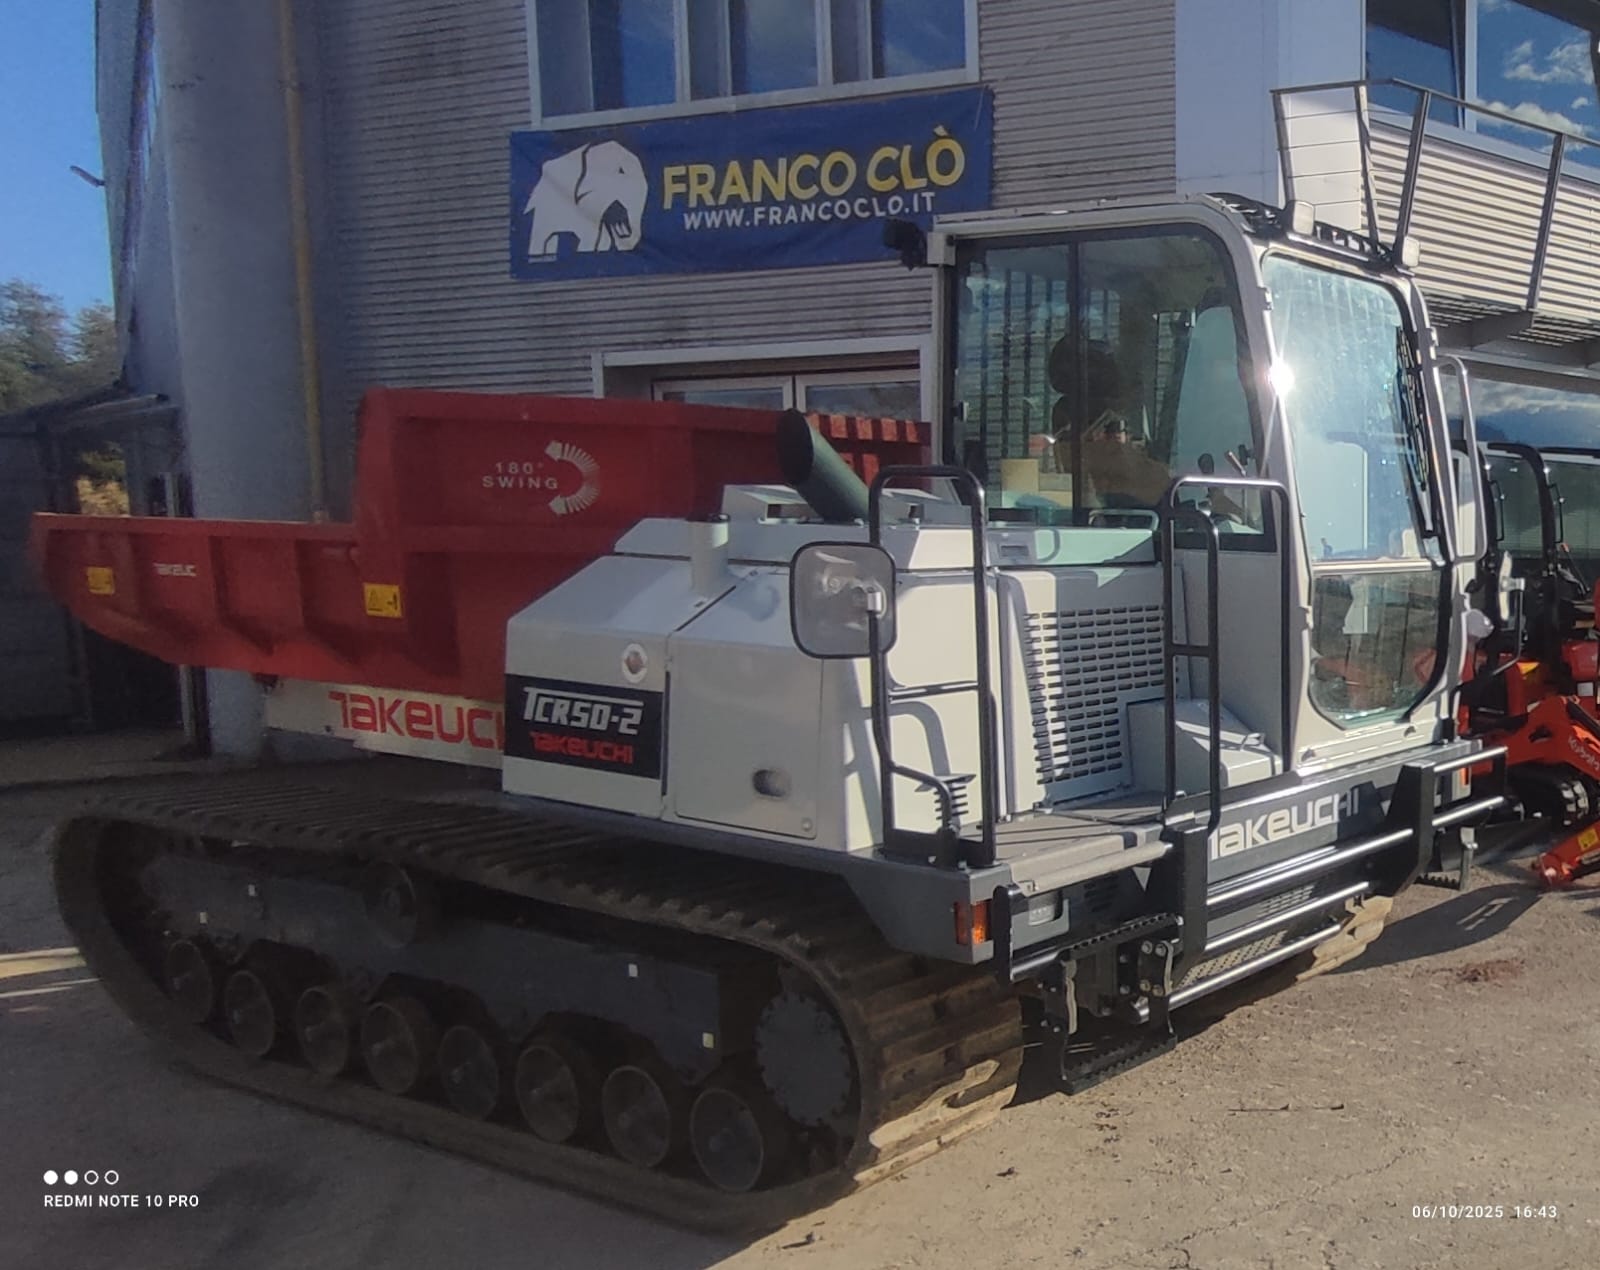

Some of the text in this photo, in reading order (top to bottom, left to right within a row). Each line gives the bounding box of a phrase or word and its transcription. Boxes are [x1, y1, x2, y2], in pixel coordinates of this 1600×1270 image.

[663, 125, 966, 209] FRANCO CLÒ
[683, 192, 936, 231] WWW.FRANCOCLO.IT
[482, 475, 558, 489] SWING
